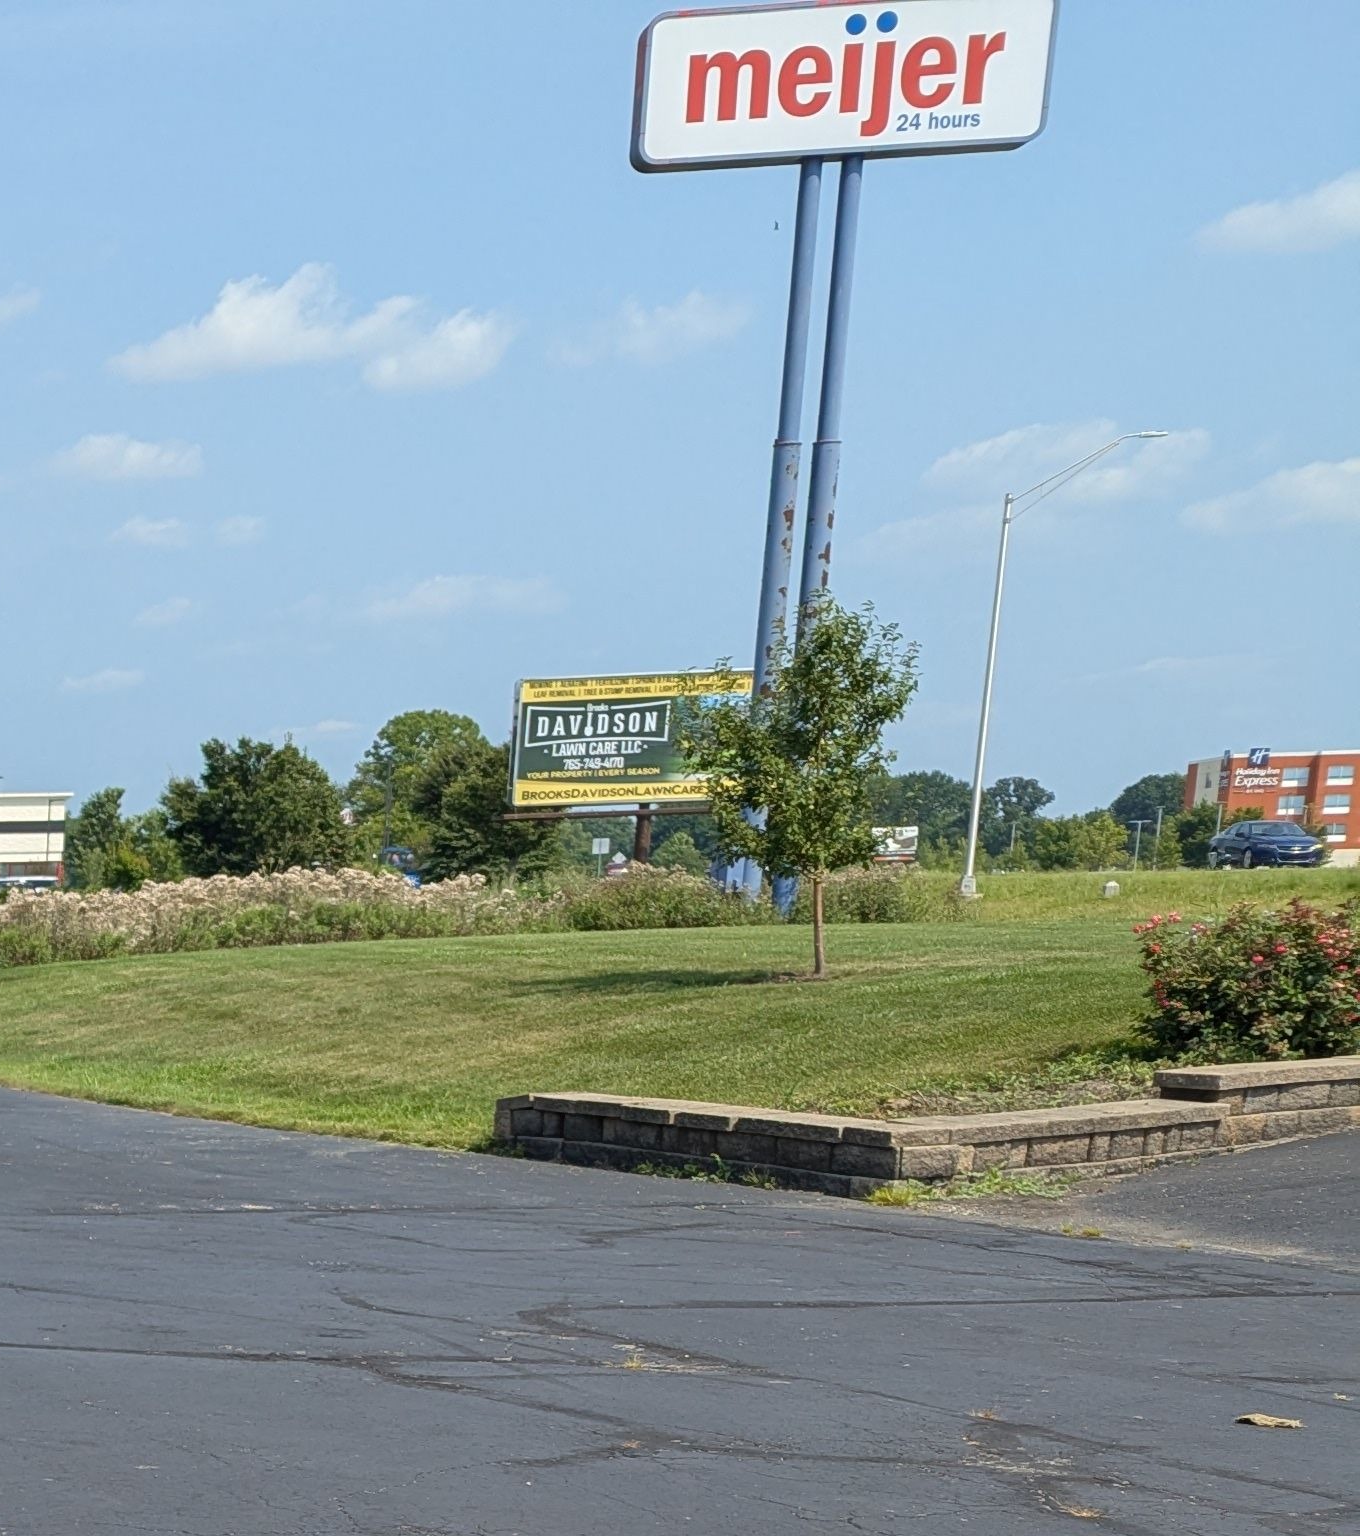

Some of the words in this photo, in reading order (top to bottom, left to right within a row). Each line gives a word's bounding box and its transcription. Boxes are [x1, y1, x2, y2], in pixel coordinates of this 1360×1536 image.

[685, 11, 1007, 137] meijer
[896, 110, 922, 132] 24
[928, 110, 981, 130] hours
[536, 711, 658, 737] DAVIDSON
[551, 742, 587, 757] LAWN
[589, 741, 618, 755] CARE
[620, 739, 642, 754] LLC
[527, 771, 549, 780] YOUR
[550, 769, 594, 779] PROPERTY
[598, 767, 625, 777] EVERY
[626, 766, 660, 776] SEASON
[1234, 775, 1279, 788] Express
